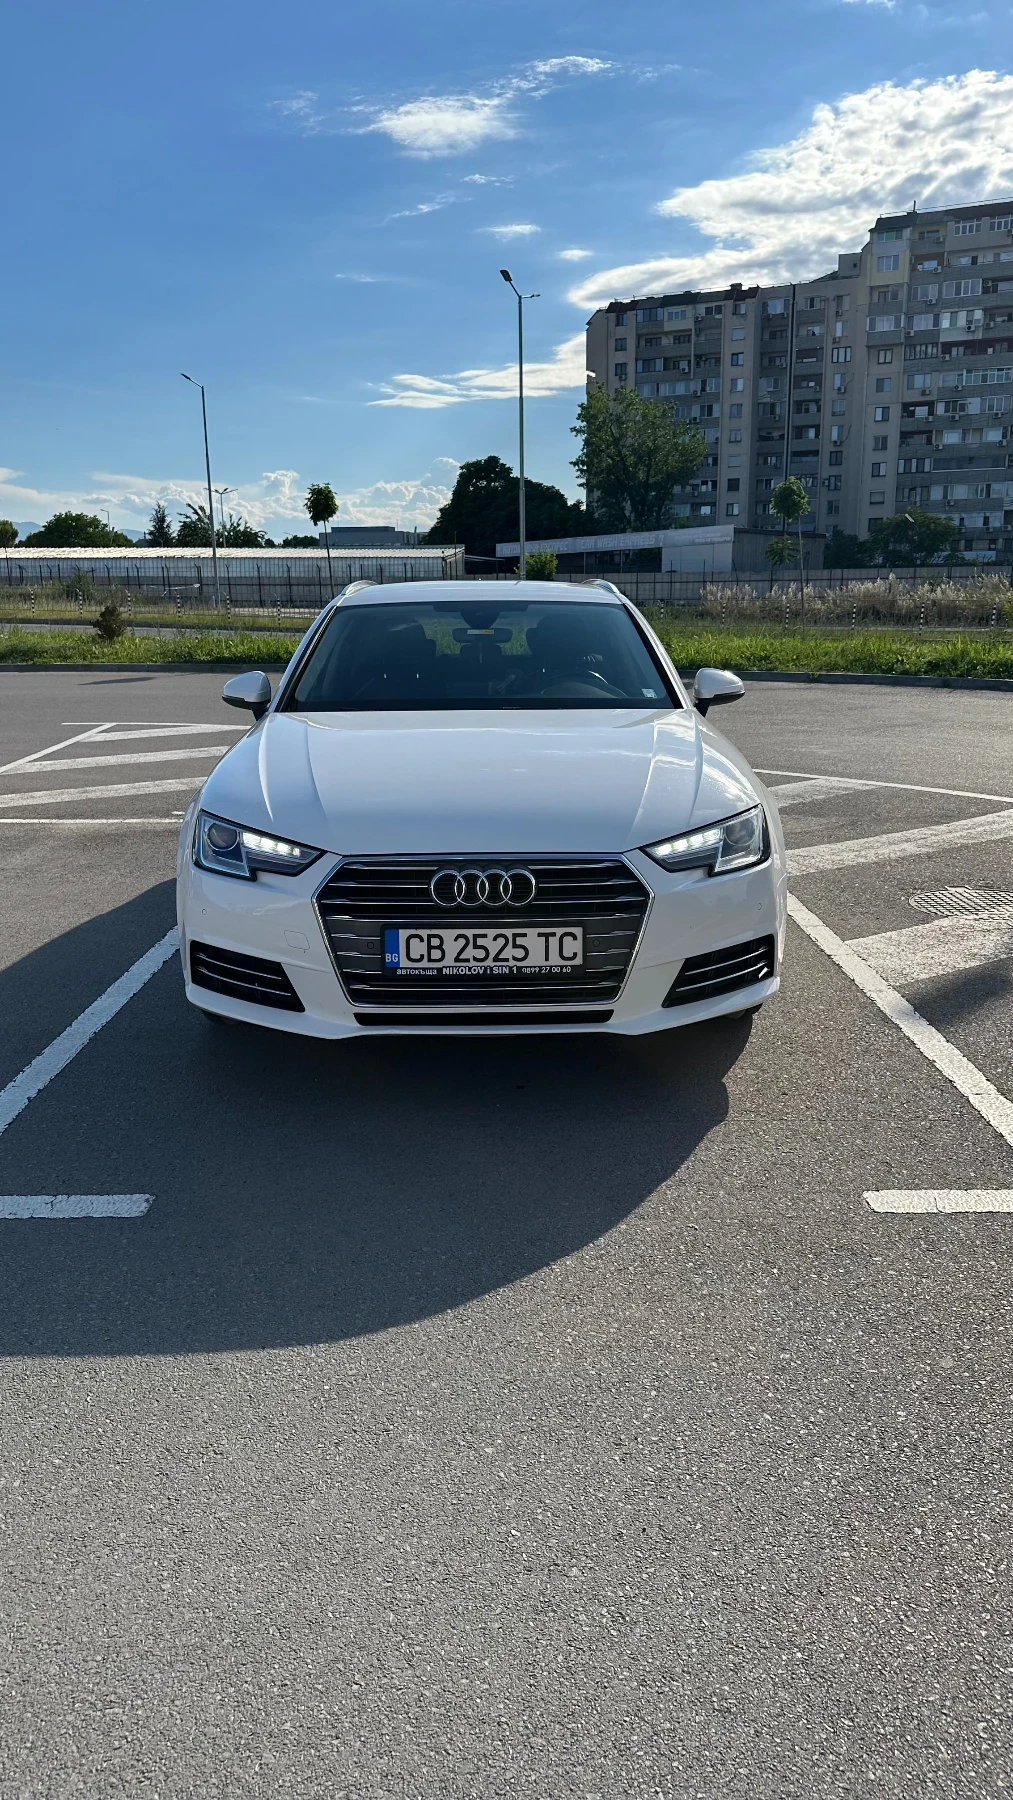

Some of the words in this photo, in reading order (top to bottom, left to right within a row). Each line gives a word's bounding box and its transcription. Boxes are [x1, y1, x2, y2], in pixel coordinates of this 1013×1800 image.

[580, 538, 595, 549] CAR
[597, 536, 618, 548] WASH
[620, 534, 656, 547] EXPRESS
[405, 933, 446, 963] CB
[453, 932, 530, 963] 2525
[537, 931, 578, 962] TC
[385, 953, 399, 963] BG
[442, 966, 485, 975] NIKOLOV
[492, 966, 509, 974] SIN
[512, 966, 517, 974] 1
